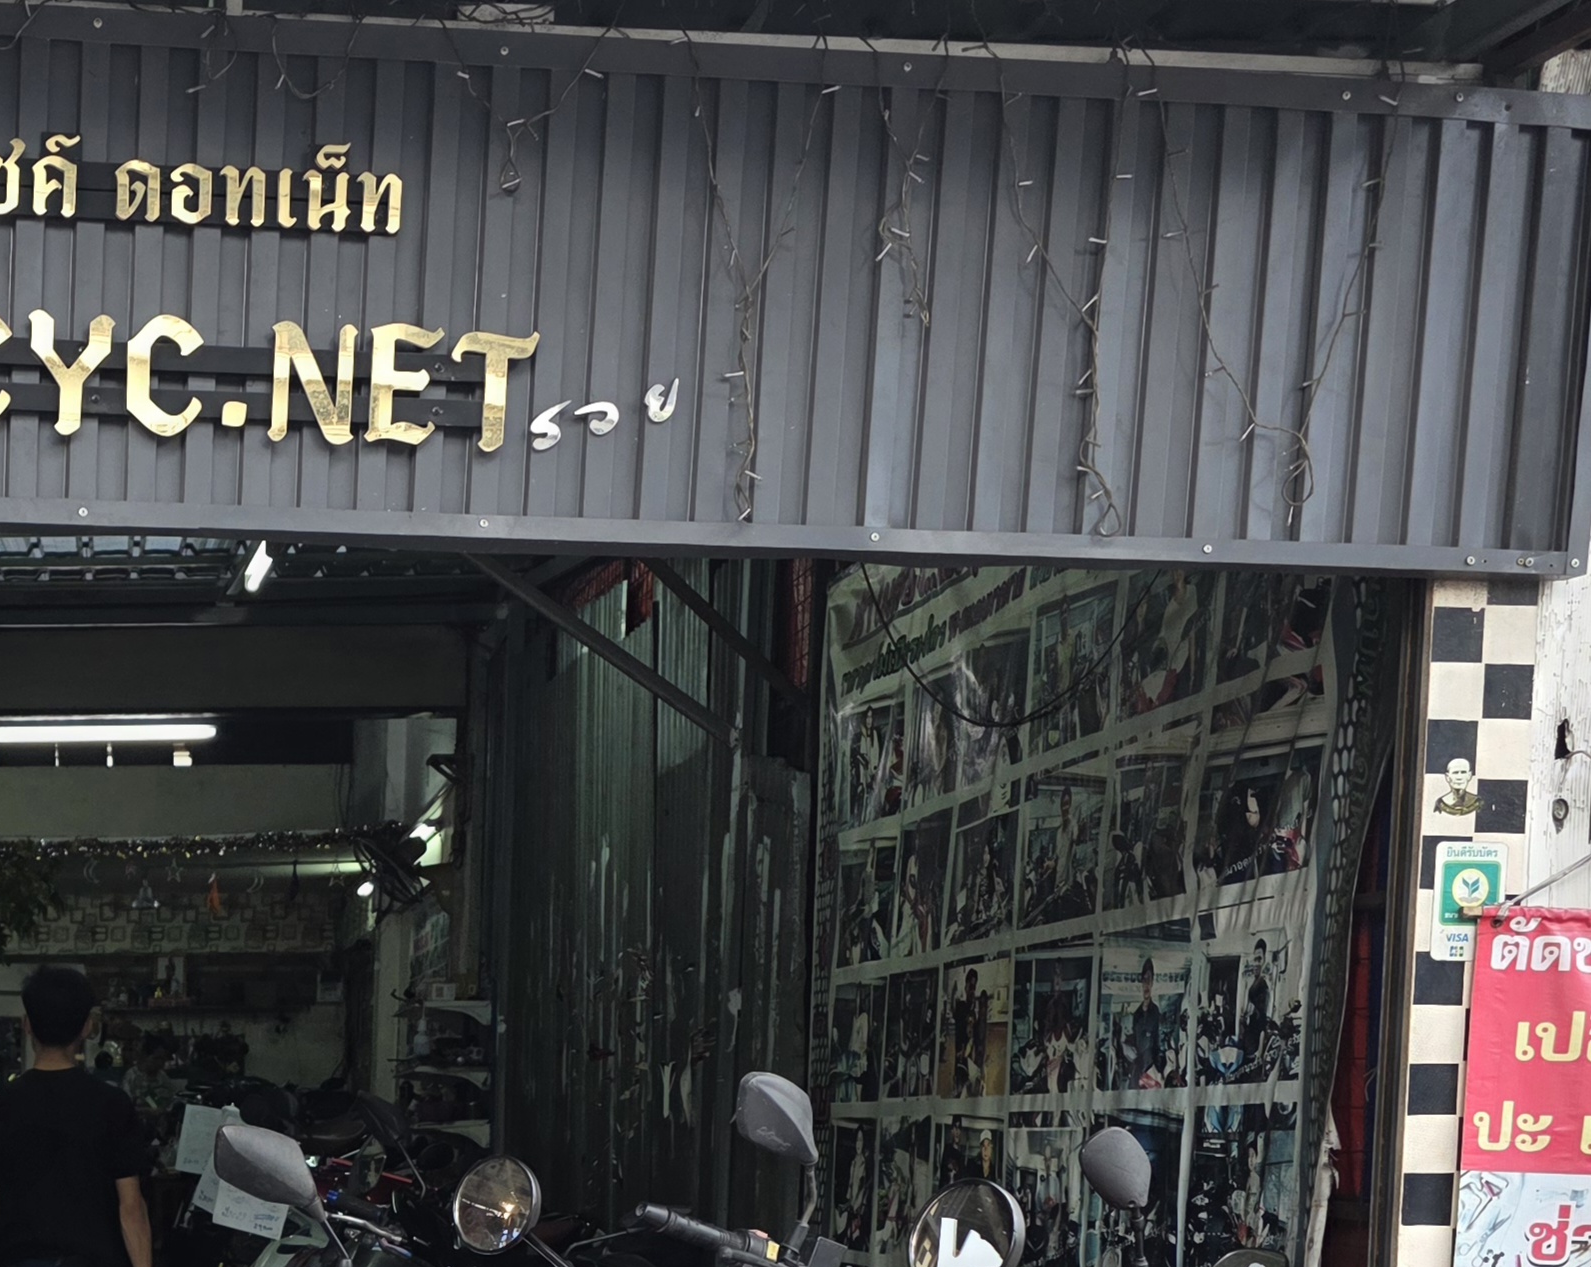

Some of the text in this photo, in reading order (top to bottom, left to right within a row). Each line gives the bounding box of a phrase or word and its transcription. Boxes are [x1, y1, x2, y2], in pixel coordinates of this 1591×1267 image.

[114, 142, 403, 236] ดอทเน็ท
[1446, 845, 1499, 858] ยินดีรับบัตร
[1445, 933, 1470, 943] VISA
[1514, 1010, 1591, 1063] เป
[1473, 1100, 1554, 1153] ปะ
